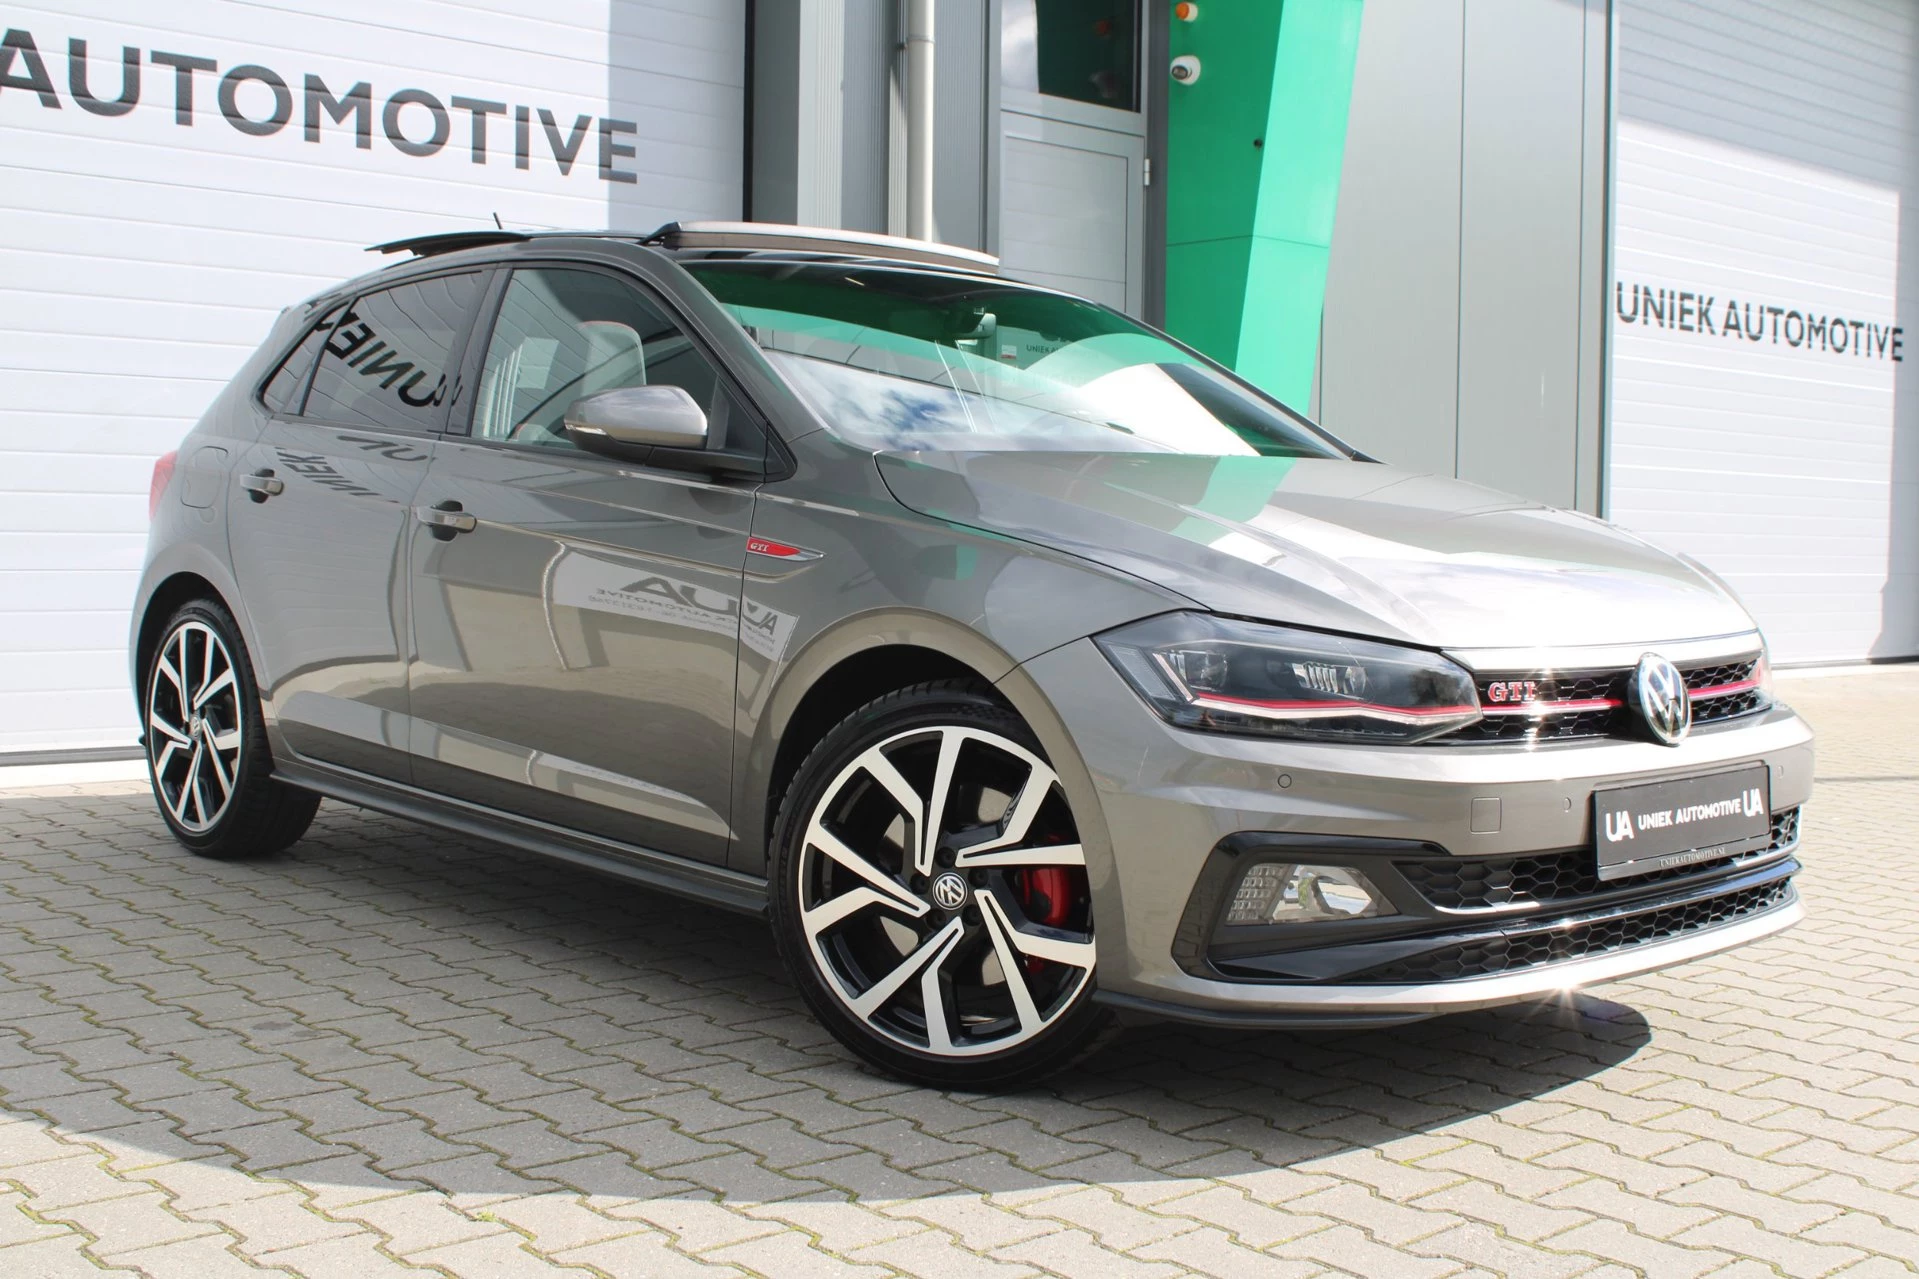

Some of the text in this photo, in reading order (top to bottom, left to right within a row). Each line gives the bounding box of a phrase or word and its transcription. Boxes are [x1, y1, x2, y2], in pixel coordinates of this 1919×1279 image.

[0, 28, 637, 184] AUTOMOTIVE
[1616, 281, 1904, 362] UNIEK AUTOMOTIVE
[750, 543, 769, 552] GTI
[1488, 681, 1536, 702] GTI
[1605, 788, 1764, 842] UA UNIEK AUTOMOTIVE UA
